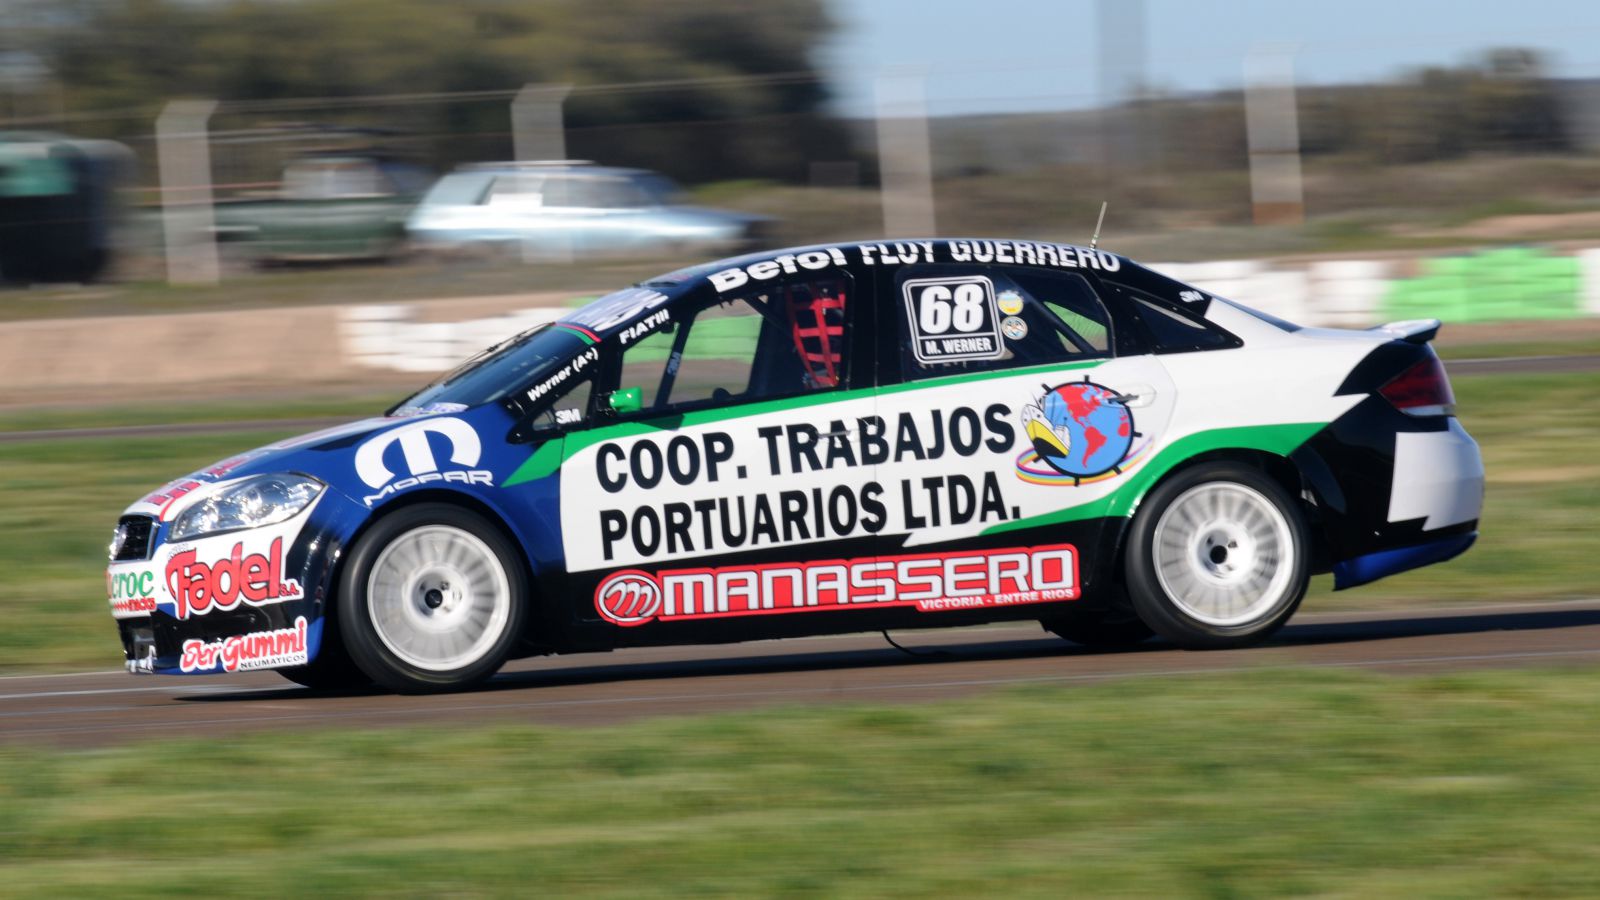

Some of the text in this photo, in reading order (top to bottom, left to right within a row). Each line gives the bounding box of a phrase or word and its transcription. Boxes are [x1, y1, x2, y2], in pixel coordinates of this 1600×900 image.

[919, 283, 985, 335] 68
[924, 337, 993, 355] M. WERNER
[526, 364, 572, 402] Werner
[555, 408, 582, 425] 3M
[596, 403, 1015, 494] COOP. TRABAJOS
[363, 469, 494, 507] MOPAR
[600, 471, 1021, 561] PORTUARIOS LTDA.
[165, 536, 283, 620] Fadel
[662, 549, 1074, 616] MANASSERO
[919, 596, 984, 610] VICTORIA
[994, 591, 1039, 604] ENTRE
[1041, 589, 1074, 599] RIOS
[240, 654, 306, 669] NEUMATICOS
